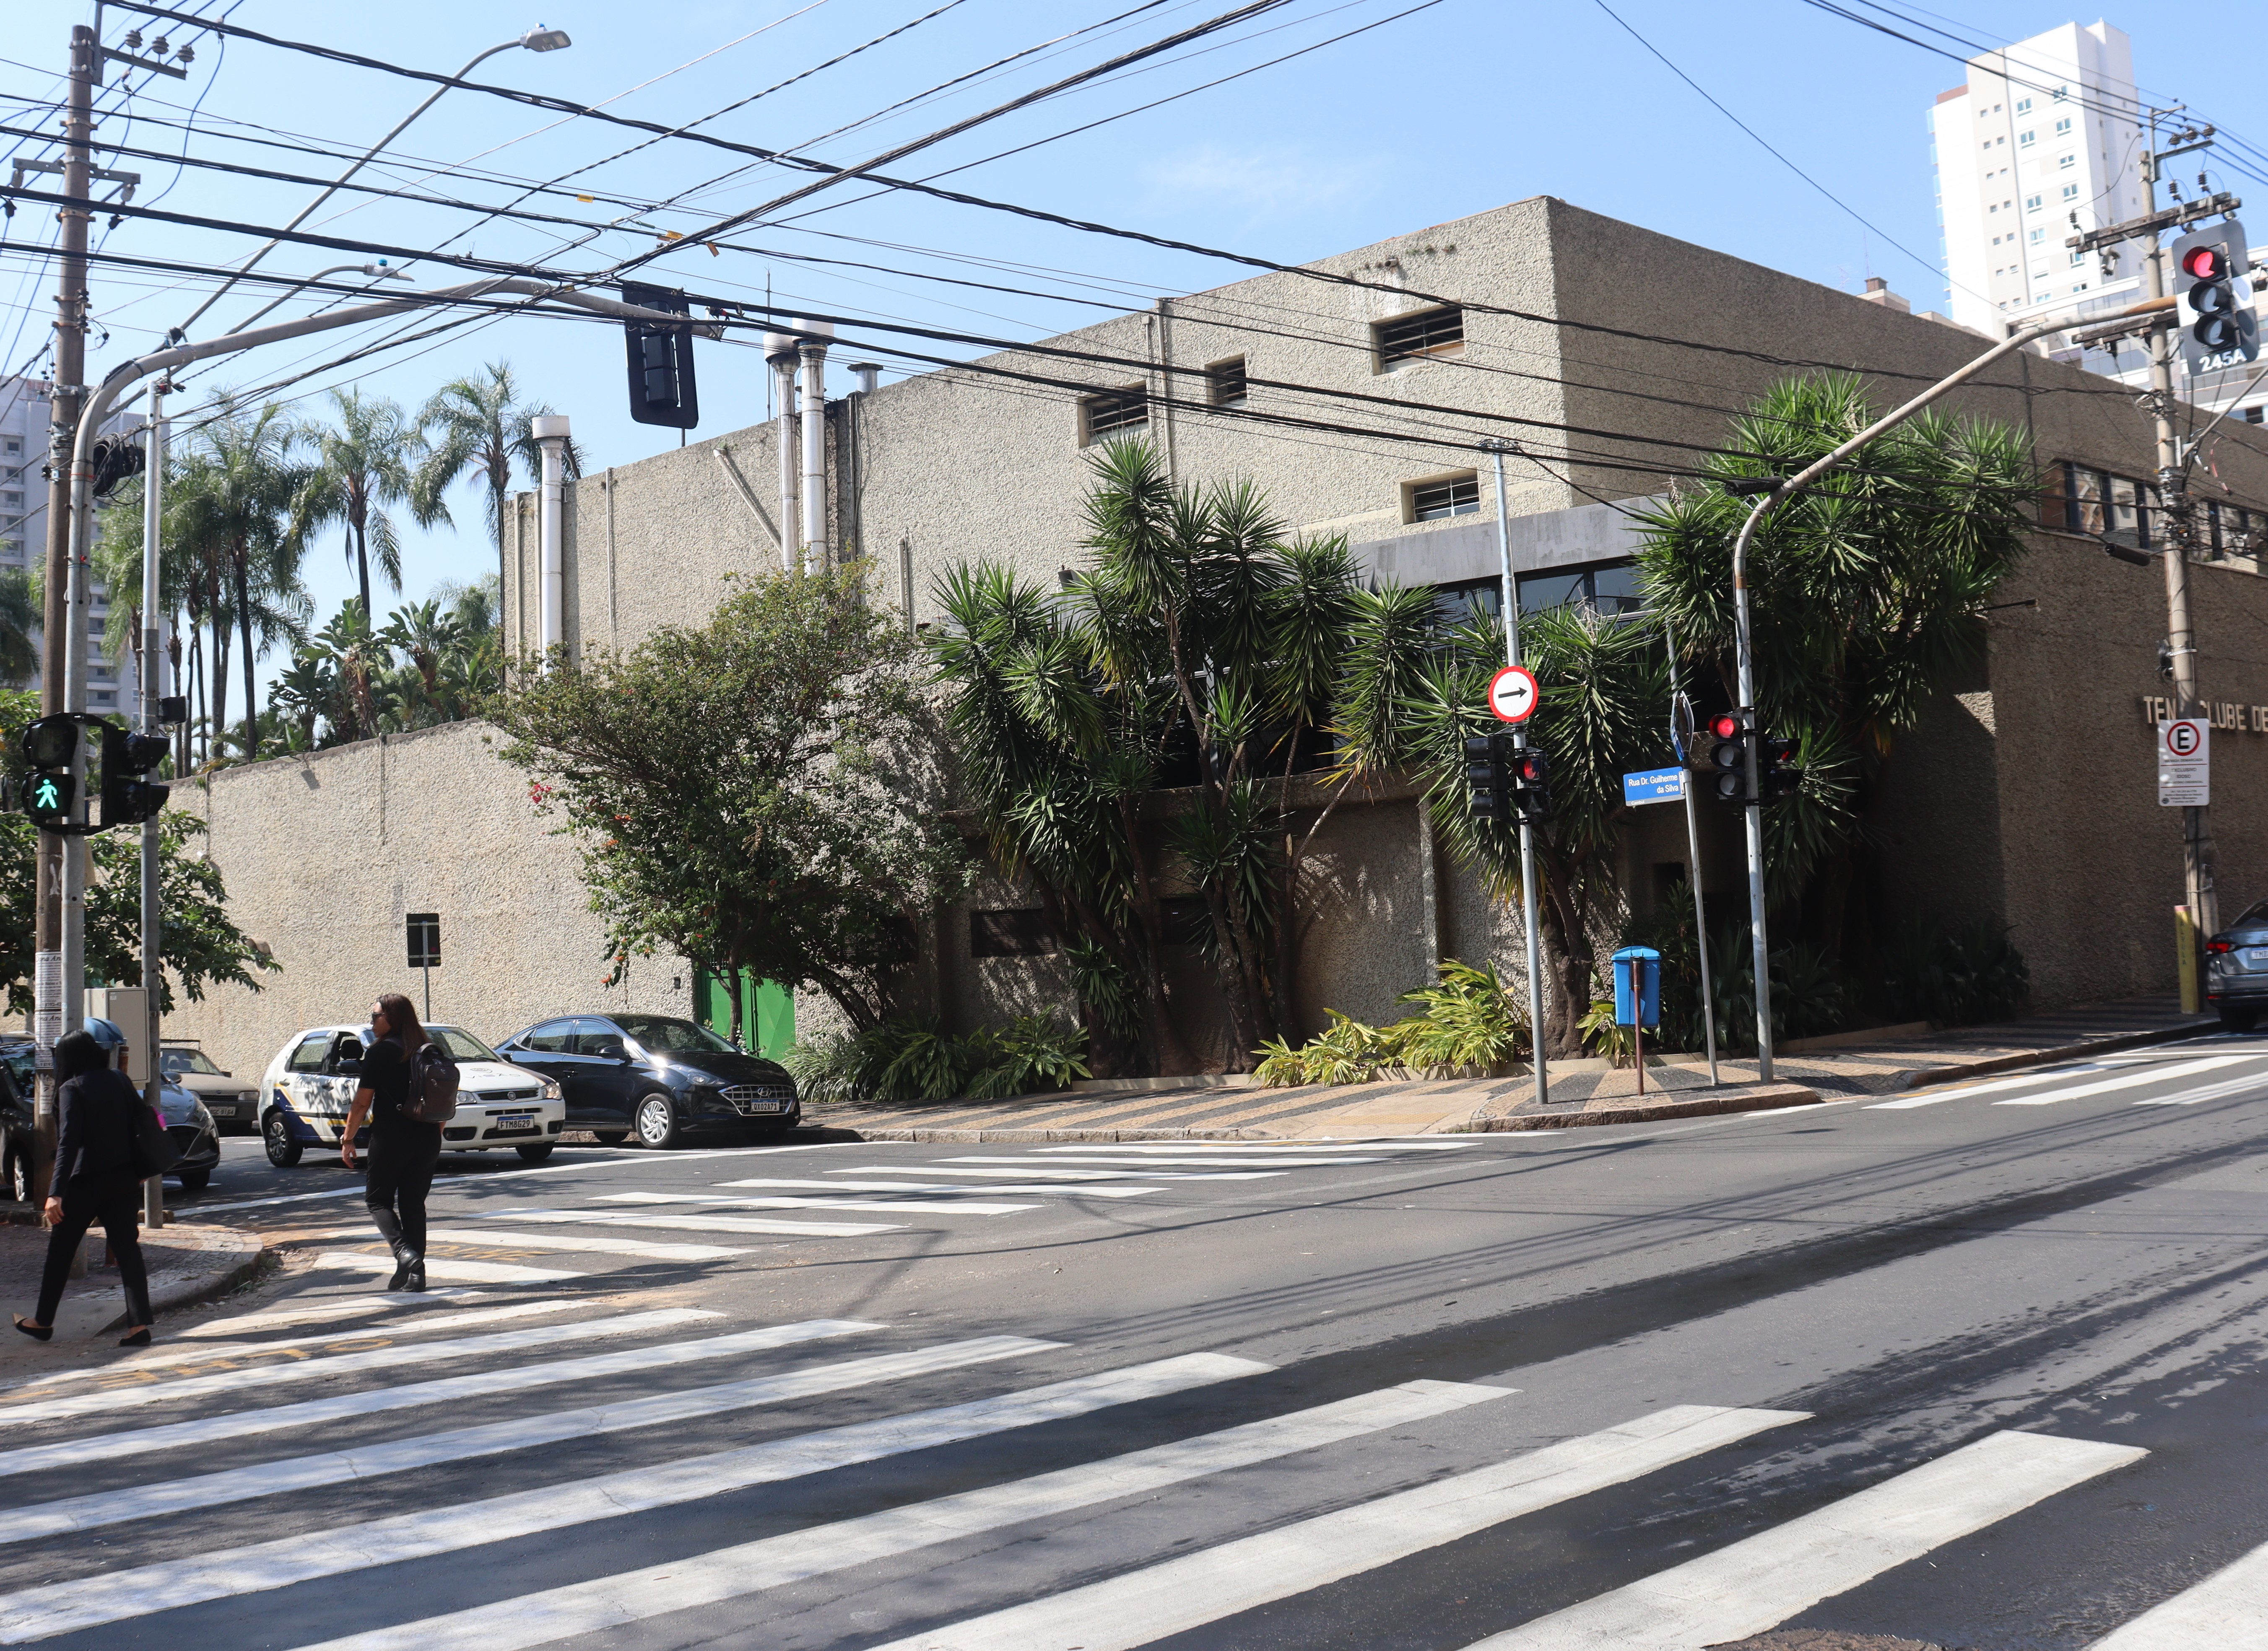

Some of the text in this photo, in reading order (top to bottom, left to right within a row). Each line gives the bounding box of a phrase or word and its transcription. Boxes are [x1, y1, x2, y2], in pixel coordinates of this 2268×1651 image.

[2198, 348, 2247, 372] 245A
[2143, 696, 2177, 724] TEN
[2200, 700, 2247, 730] LUBE
[2177, 728, 2190, 749] E
[1628, 779, 1640, 787] Rua
[1650, 775, 1678, 784] Guilherme
[500, 1120, 530, 1129] FTM8G29
